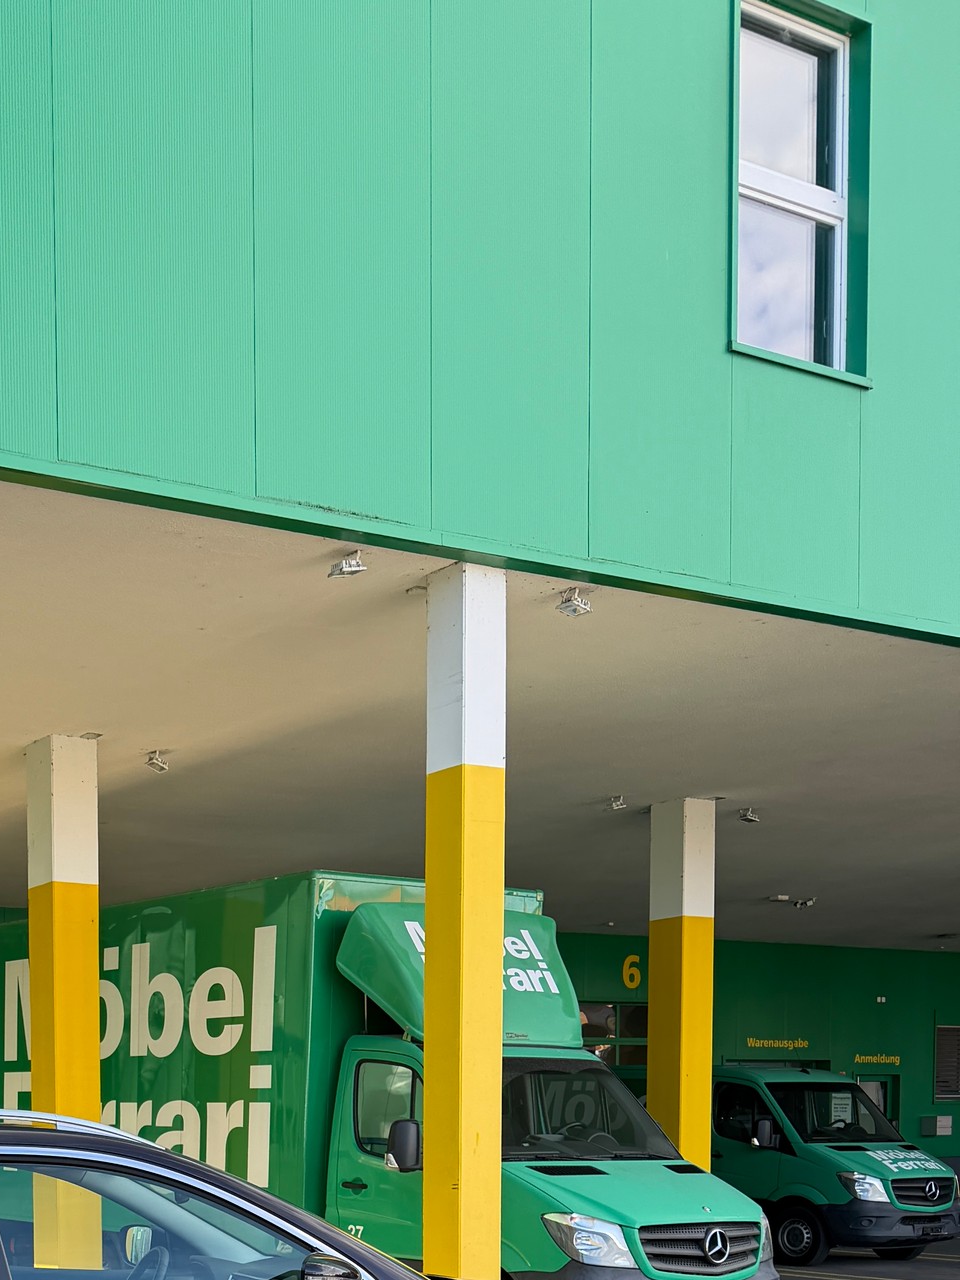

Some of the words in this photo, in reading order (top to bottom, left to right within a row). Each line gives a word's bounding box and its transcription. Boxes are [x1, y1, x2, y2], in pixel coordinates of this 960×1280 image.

[623, 954, 641, 989] 6
[746, 1037, 809, 1050] Warenausgabe
[854, 1053, 901, 1066] Anmeldung
[882, 1159, 947, 1173] Ferrari
[347, 1224, 364, 1239] 27
